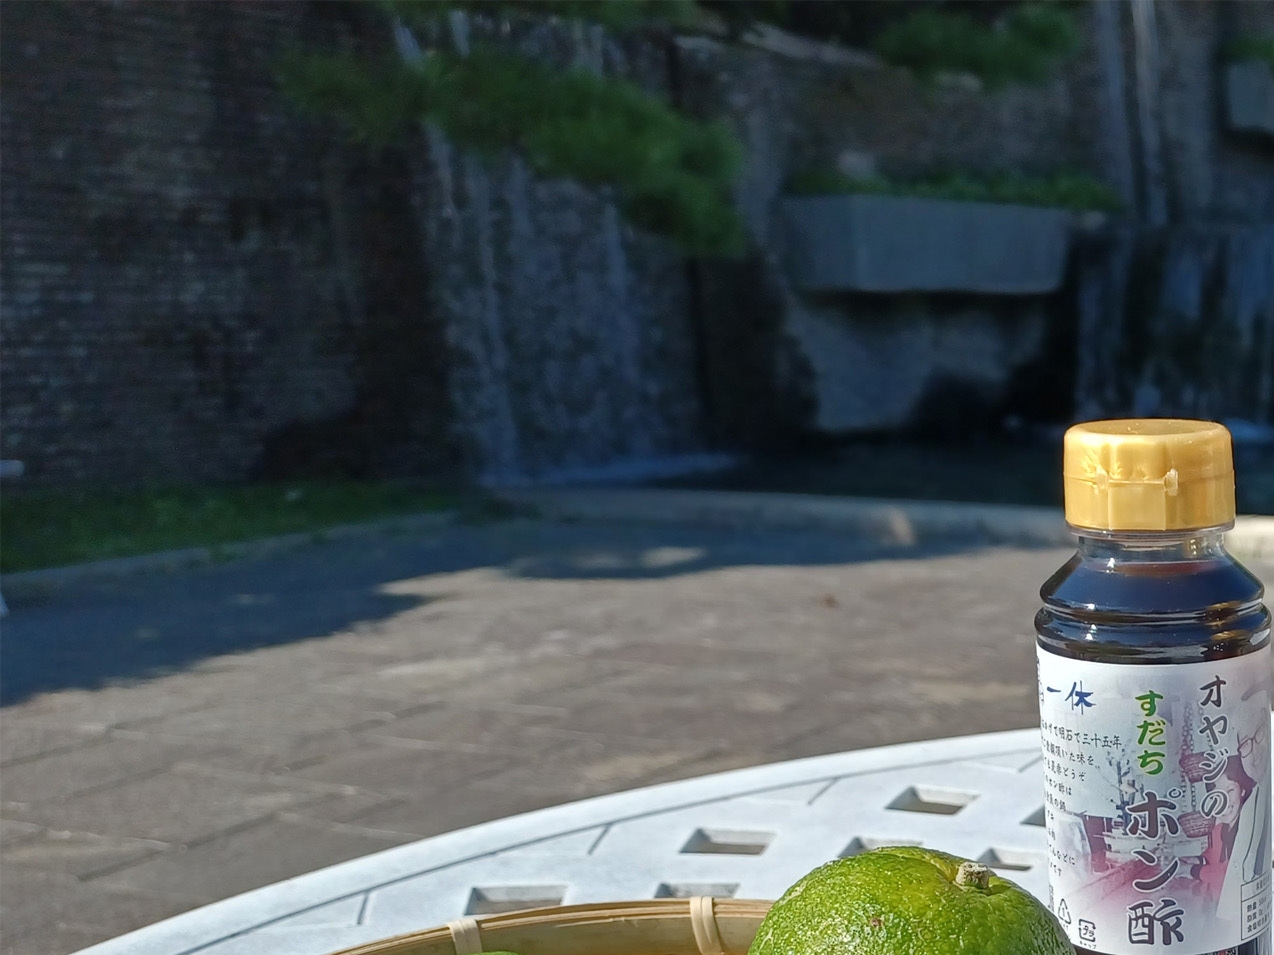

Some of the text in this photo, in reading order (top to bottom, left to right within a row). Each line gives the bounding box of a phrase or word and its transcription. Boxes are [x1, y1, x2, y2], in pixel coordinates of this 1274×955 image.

[1046, 681, 1096, 715] 一休
[1199, 675, 1229, 818] オヤジの
[1126, 690, 1185, 946] すだち ポン酢
